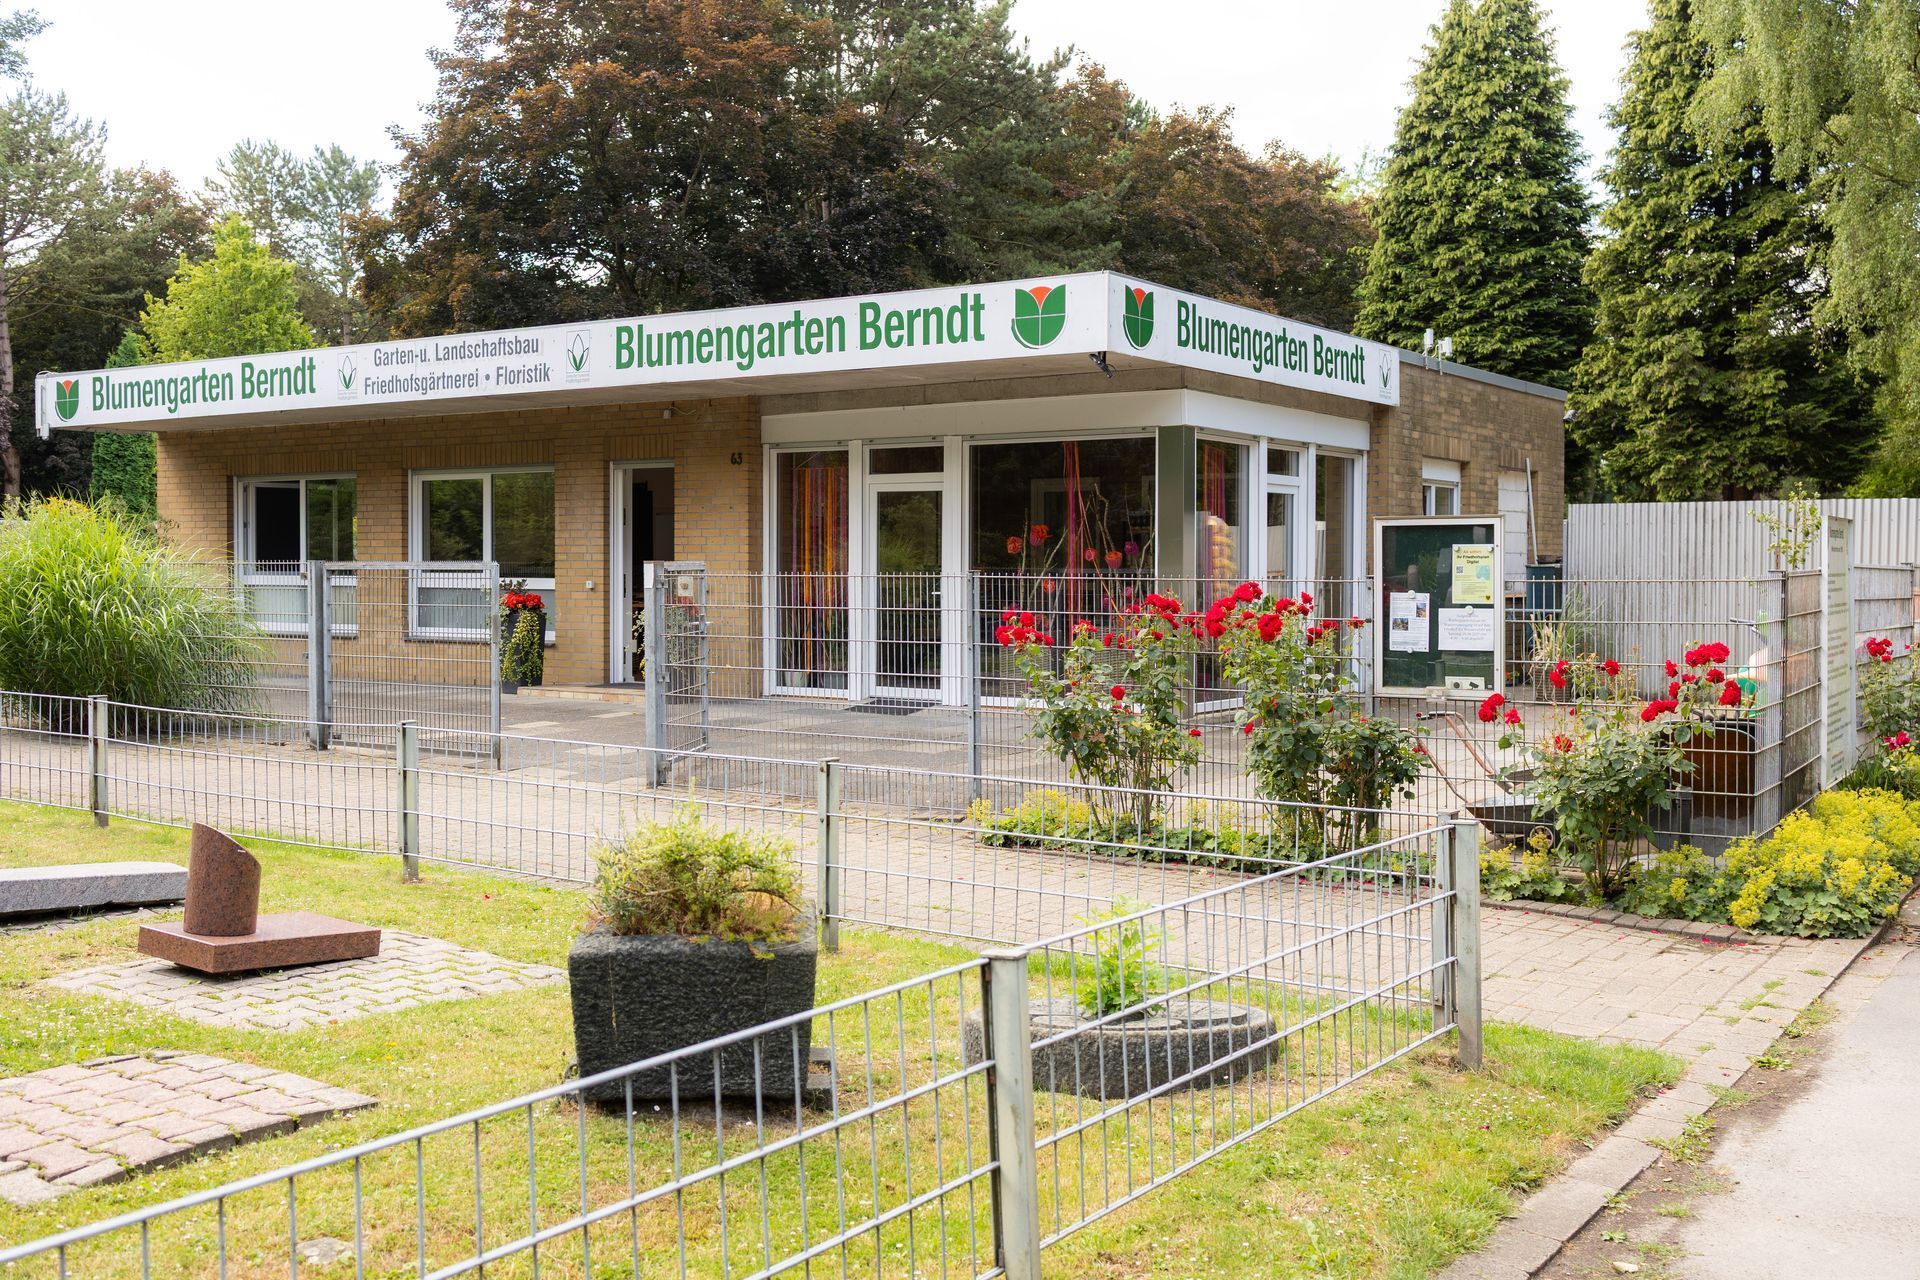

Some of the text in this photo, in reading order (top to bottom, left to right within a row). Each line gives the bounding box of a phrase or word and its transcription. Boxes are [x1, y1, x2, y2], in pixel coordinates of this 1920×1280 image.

[435, 335, 539, 362] Landschaftsbau
[614, 292, 985, 371] Blumengarten Berndt
[1177, 299, 1366, 385] Blumengarten Berndt
[92, 356, 316, 414] Blumengarten Berndt
[364, 362, 551, 396] Friedhofsgärtnerei Floristik
[730, 452, 743, 465] 63
